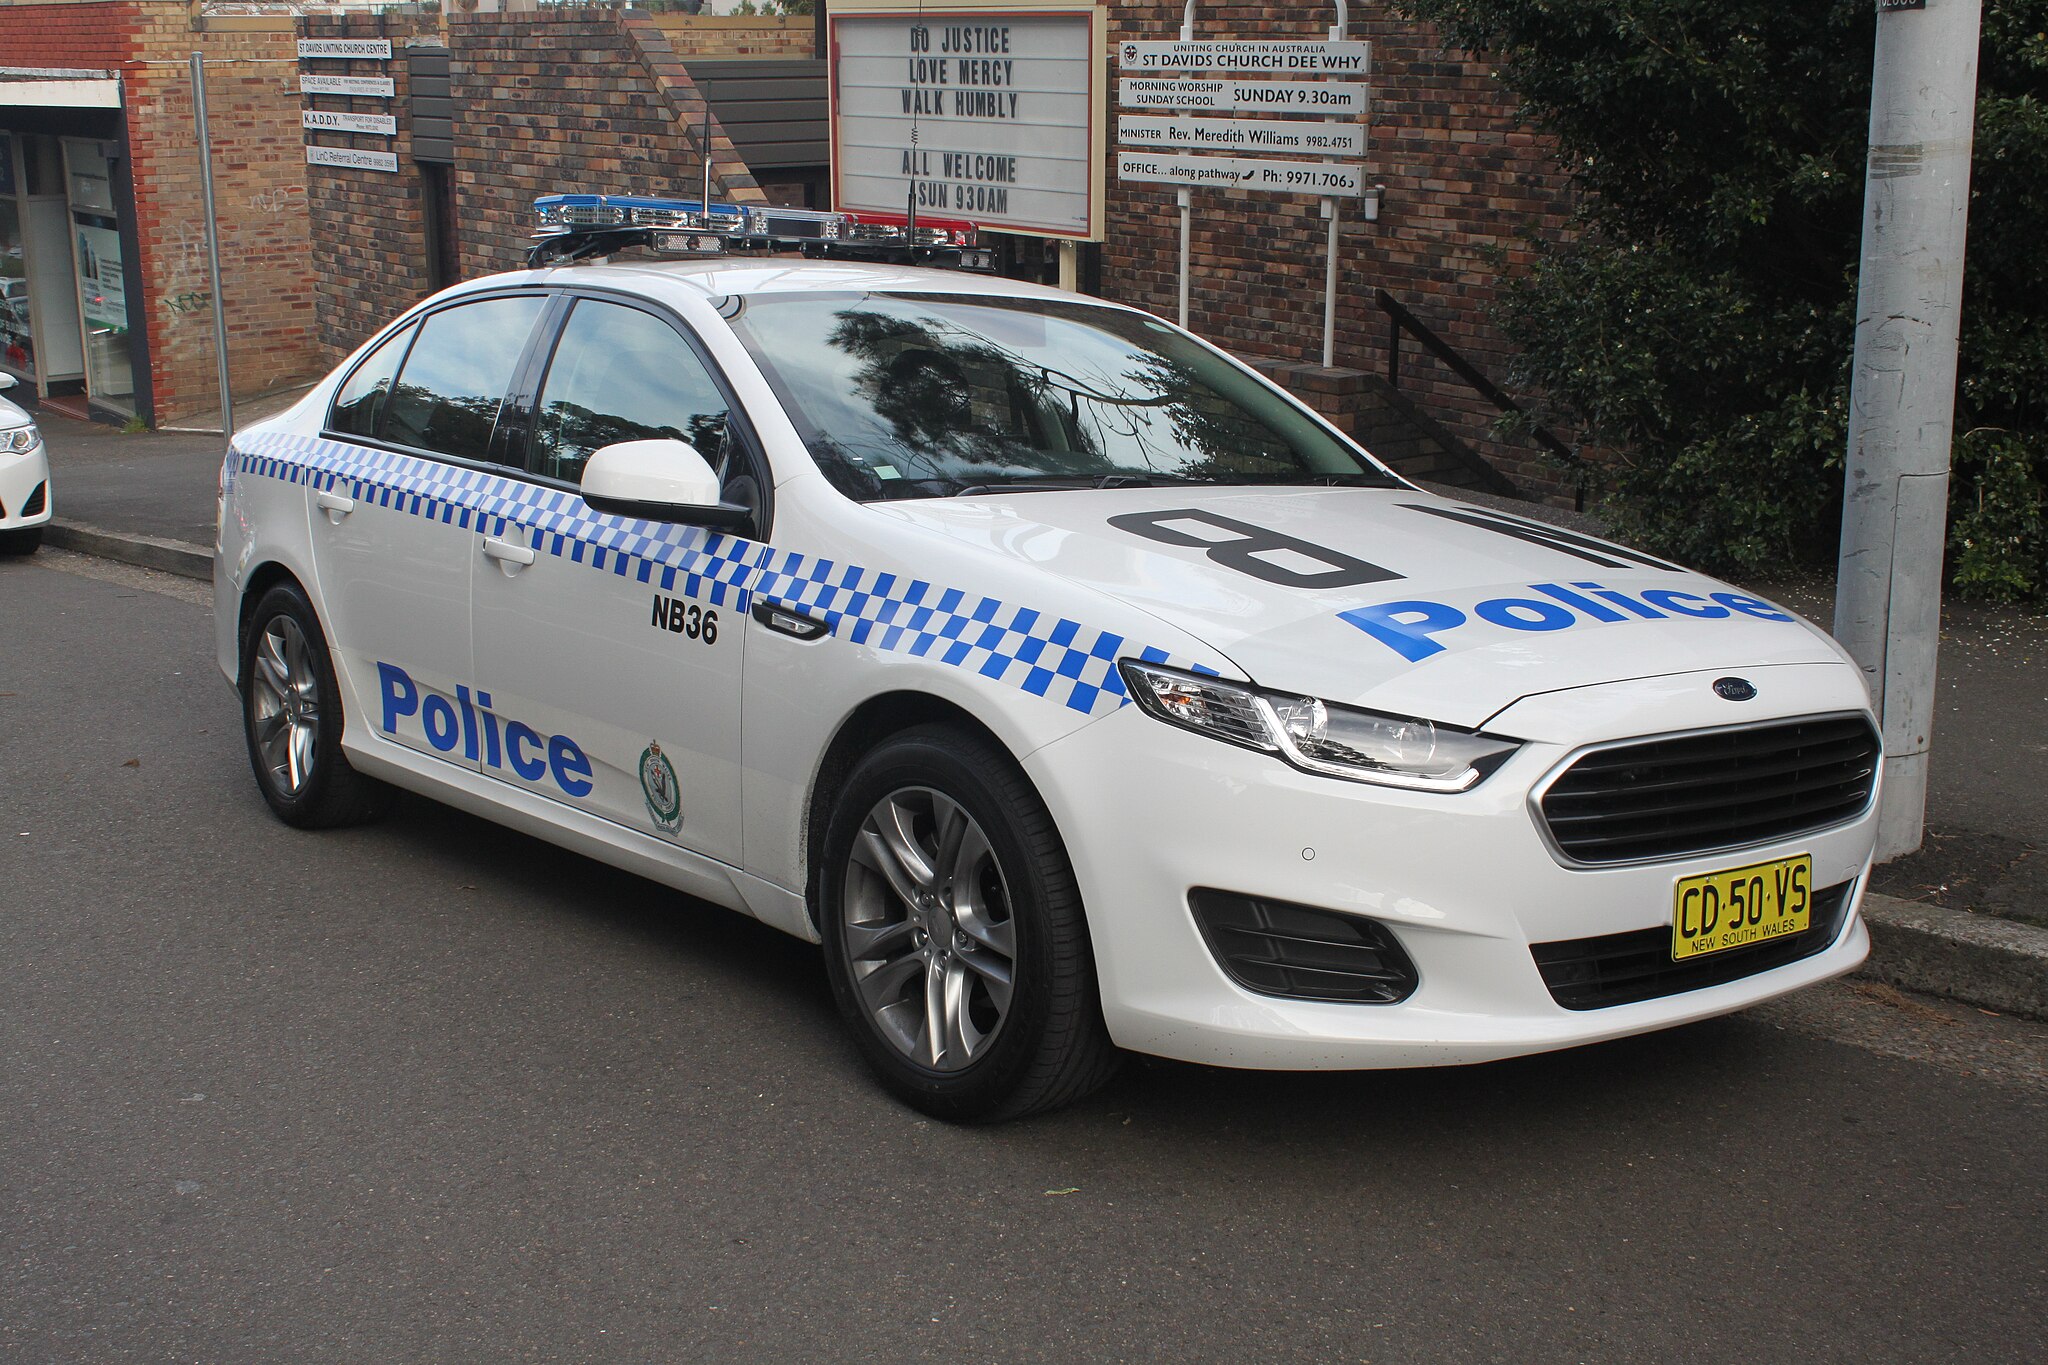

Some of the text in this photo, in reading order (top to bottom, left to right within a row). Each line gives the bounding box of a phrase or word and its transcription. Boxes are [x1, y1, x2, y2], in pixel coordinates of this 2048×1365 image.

[299, 43, 388, 55] ST DAVIDS UNITING CHURCH CENTRE
[910, 27, 1009, 53] DO JUSTICE
[1173, 44, 1326, 53] UNITING CHURCH IN AUSTRALIA
[909, 59, 1012, 86] LOVE MERCY
[1142, 54, 1362, 69] ST DAVIDS CHURCH DEE WHY
[1129, 81, 1223, 93] MORNING WORSHIP
[1233, 88, 1351, 105] SUNDAY 9.30am
[902, 89, 1017, 118] WALK HUMBLY
[1136, 94, 1215, 106] SUNDAY SCHOOL
[304, 114, 340, 126] K.A.D.D.Y.
[1120, 126, 1352, 148] MINISTER Rev. Meredith Williams 9982.4751
[329, 151, 351, 164] Referral
[352, 153, 372, 166] Centre
[902, 150, 1016, 183] ALL WELCOME
[1123, 162, 1167, 175] OFFICE...
[1169, 166, 1196, 180] along
[1198, 168, 1240, 182] pathway
[1263, 169, 1282, 183] Ph:
[918, 181, 1008, 214] SUN 930AM
[651, 593, 719, 646] NB36
[1334, 581, 1796, 663] Police
[376, 660, 594, 798] Police
[1691, 918, 1796, 953] NEW SOUTH WALES
